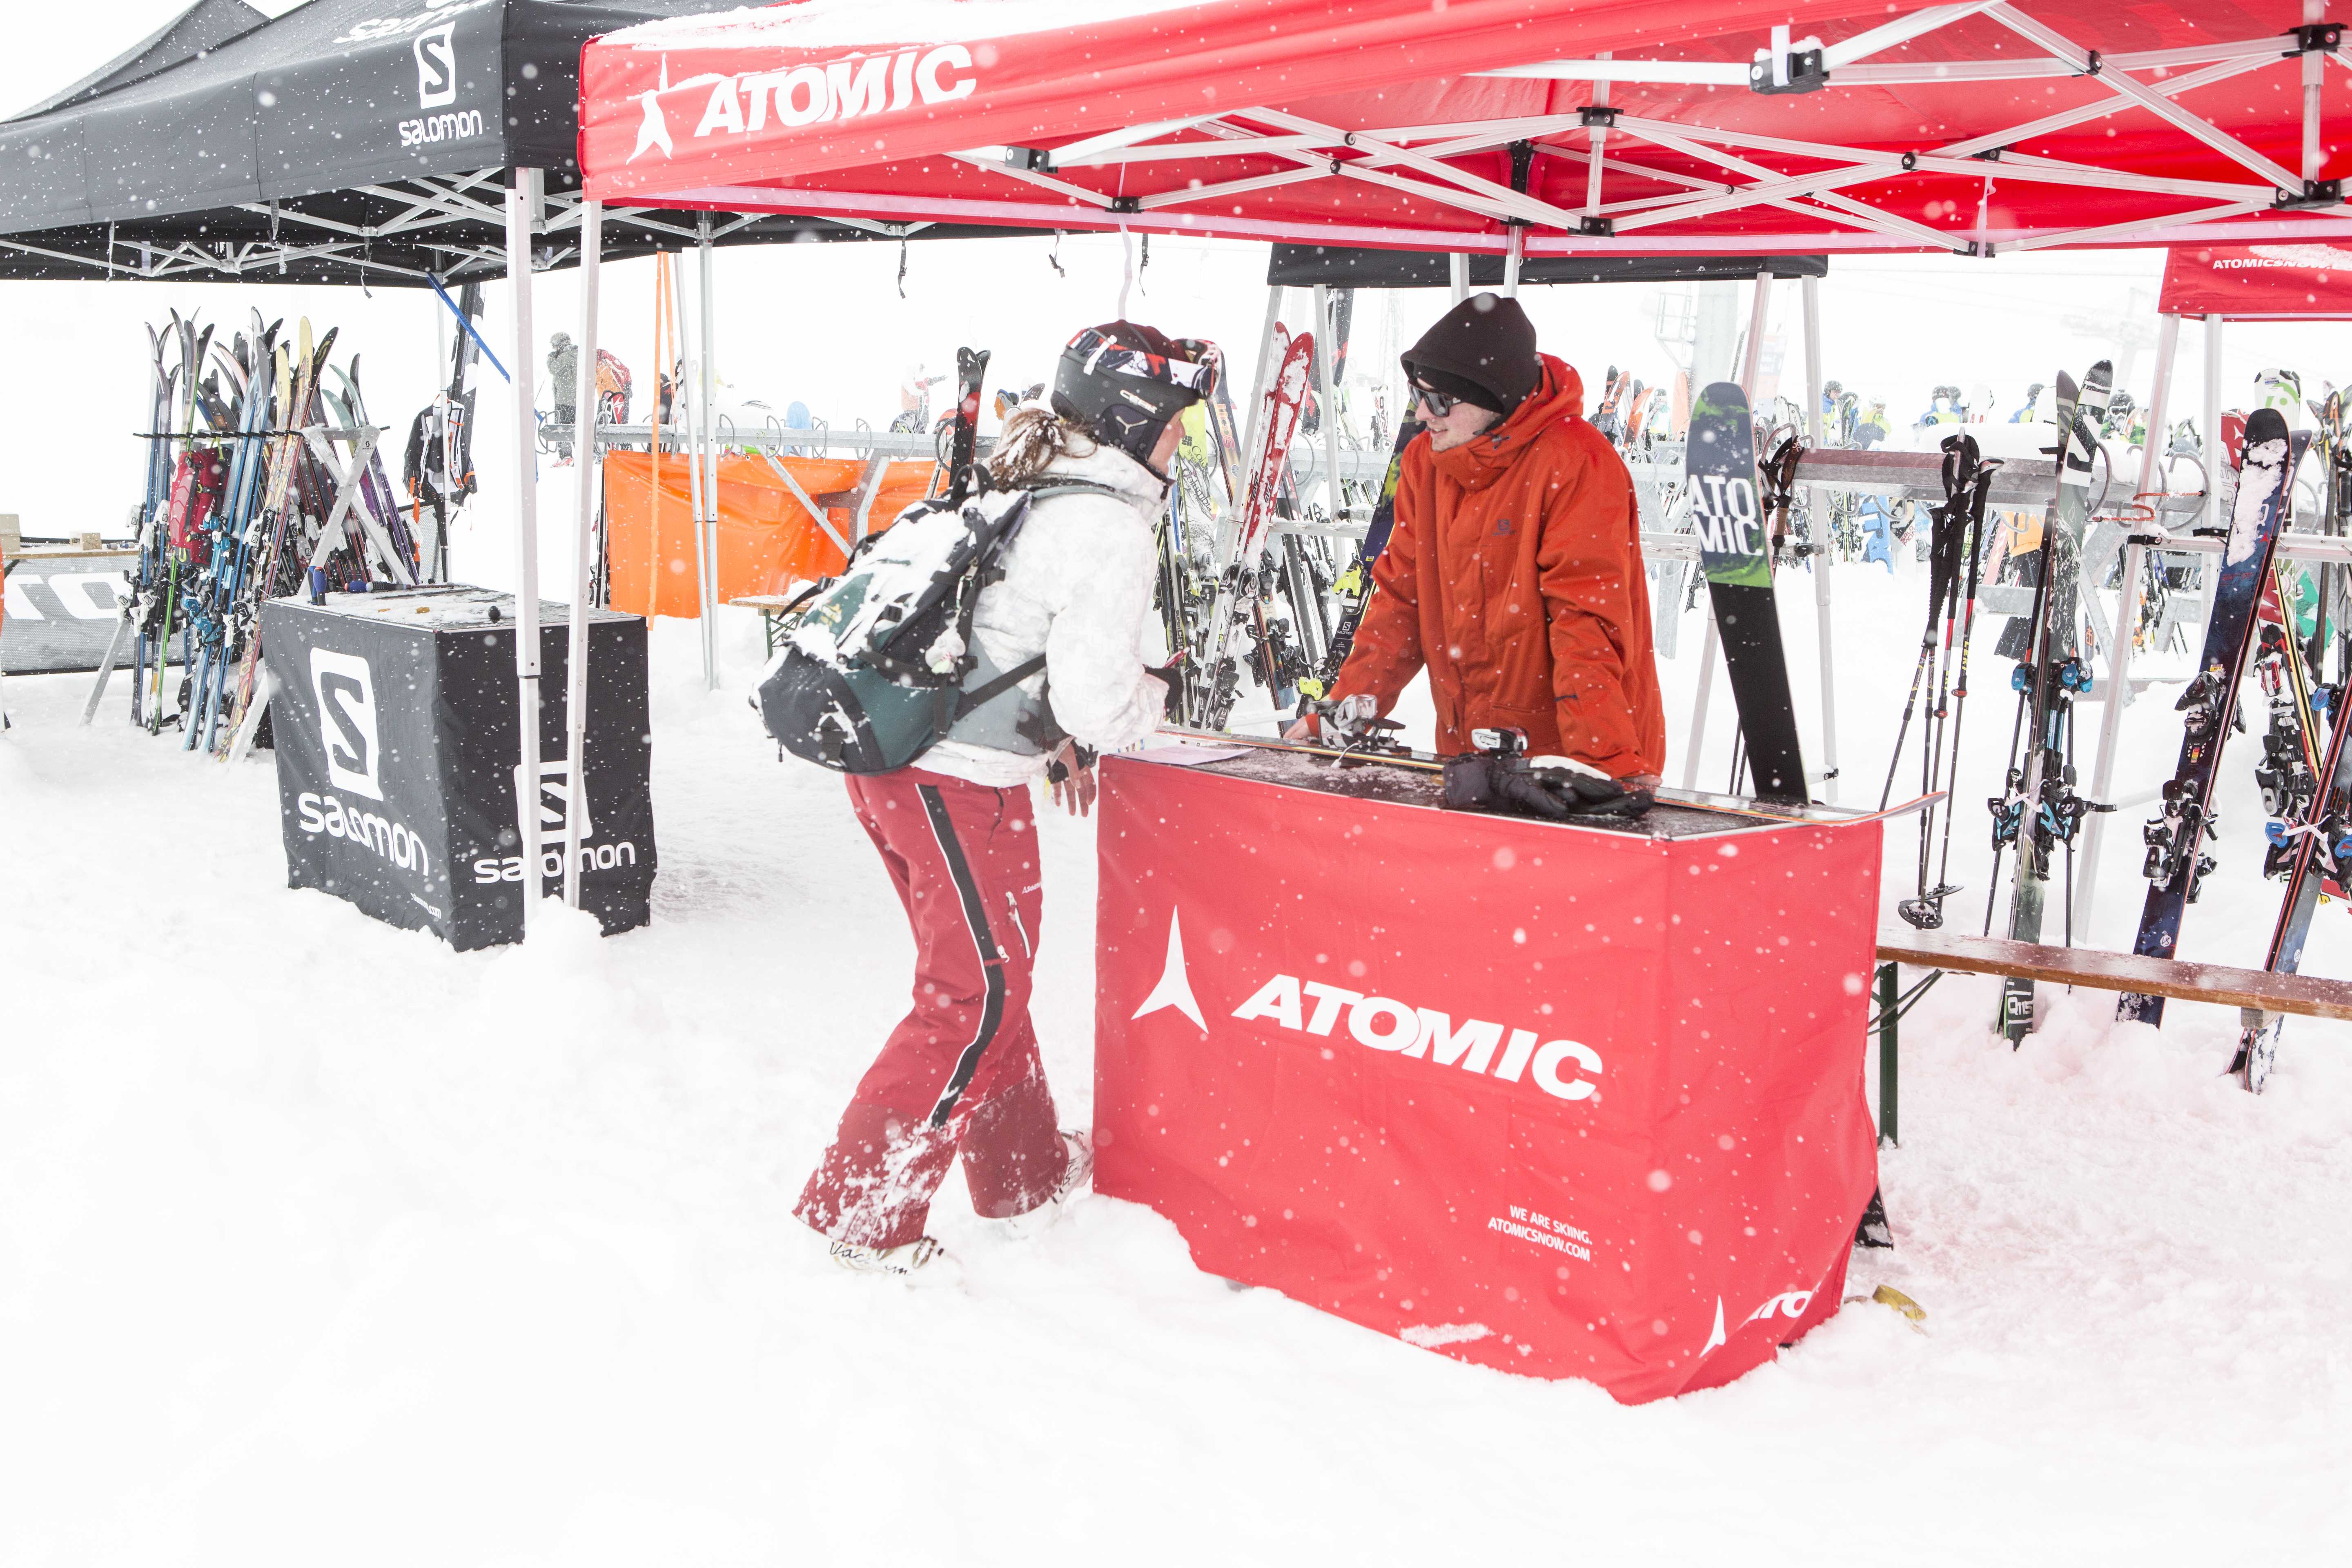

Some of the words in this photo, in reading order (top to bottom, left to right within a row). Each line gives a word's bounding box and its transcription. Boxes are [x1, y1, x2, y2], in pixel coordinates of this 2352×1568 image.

[694, 44, 977, 137] ATOMIC
[1690, 475, 1757, 522] ATO
[1692, 515, 1763, 556] MIC
[298, 792, 430, 876] salomon
[474, 842, 636, 884] saomon
[2008, 996, 2033, 1016] Q115
[1230, 973, 1604, 1100] ATOMIC
[1488, 1216, 1591, 1262] ATOMICSNOW.COM
[1510, 1205, 1528, 1221] WE
[1530, 1211, 1551, 1229] ARE
[1553, 1218, 1592, 1245] SKIING.
